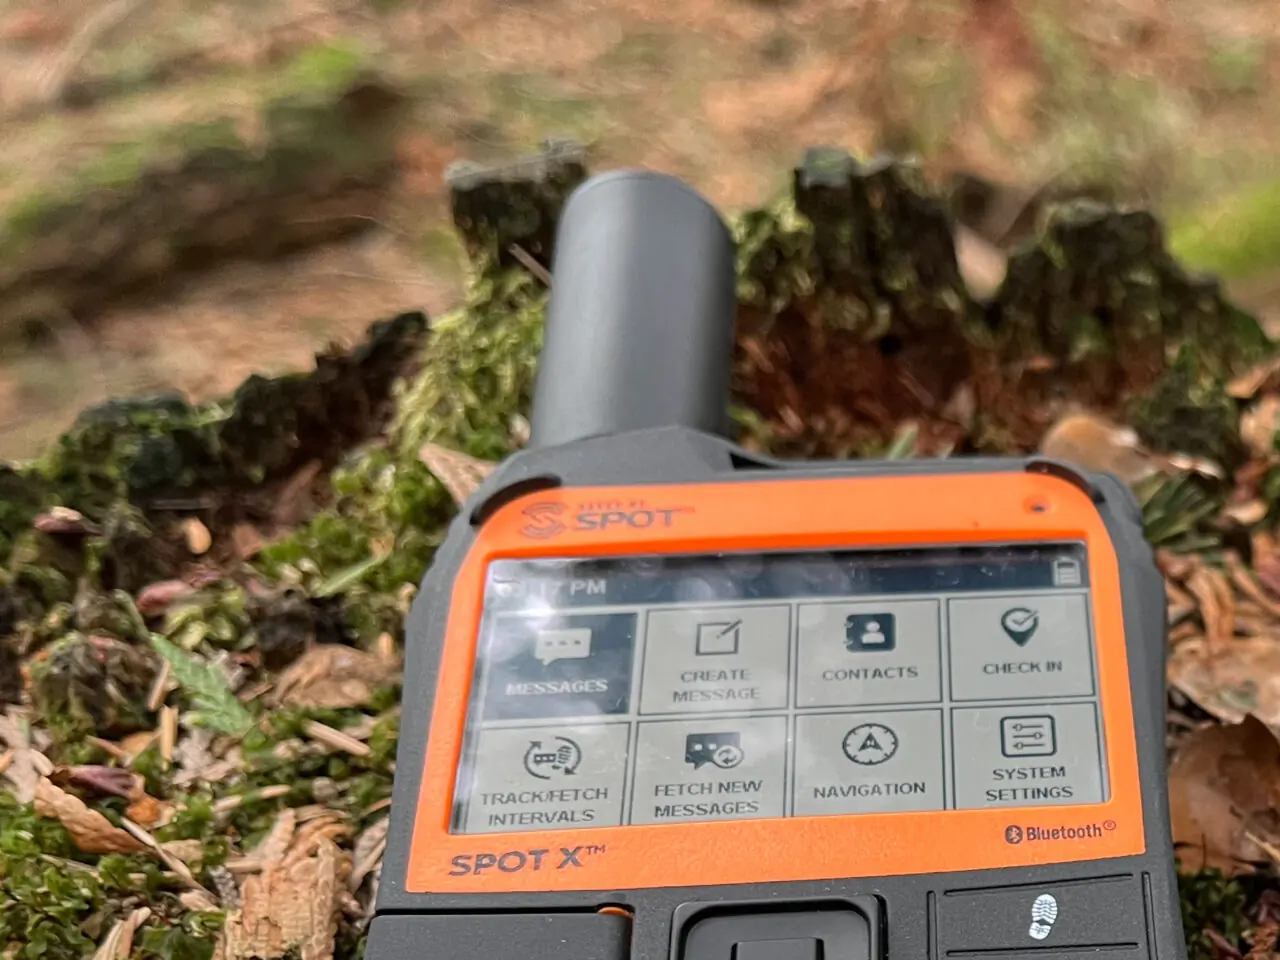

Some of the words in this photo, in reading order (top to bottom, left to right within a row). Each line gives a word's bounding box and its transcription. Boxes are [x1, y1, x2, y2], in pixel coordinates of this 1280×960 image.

[574, 509, 674, 531] SPOT
[571, 579, 607, 596] PM
[680, 668, 751, 683] CREATE
[822, 666, 919, 681] CONTACTS
[983, 661, 1041, 675] CHECK
[1045, 660, 1062, 673] IN
[506, 679, 608, 696] MESSAGES
[672, 687, 761, 703] MESSAGE
[992, 766, 1066, 781] SYSTEM
[481, 787, 608, 806] TRACK/FETCH
[654, 781, 713, 798] FETCH
[718, 780, 763, 795] NEW
[813, 781, 926, 799] NAVIGATION
[985, 785, 1074, 801] SETTINGS
[488, 808, 595, 826] INTERVALS
[654, 801, 759, 818] MESSAGES
[449, 848, 549, 876] SPOT
